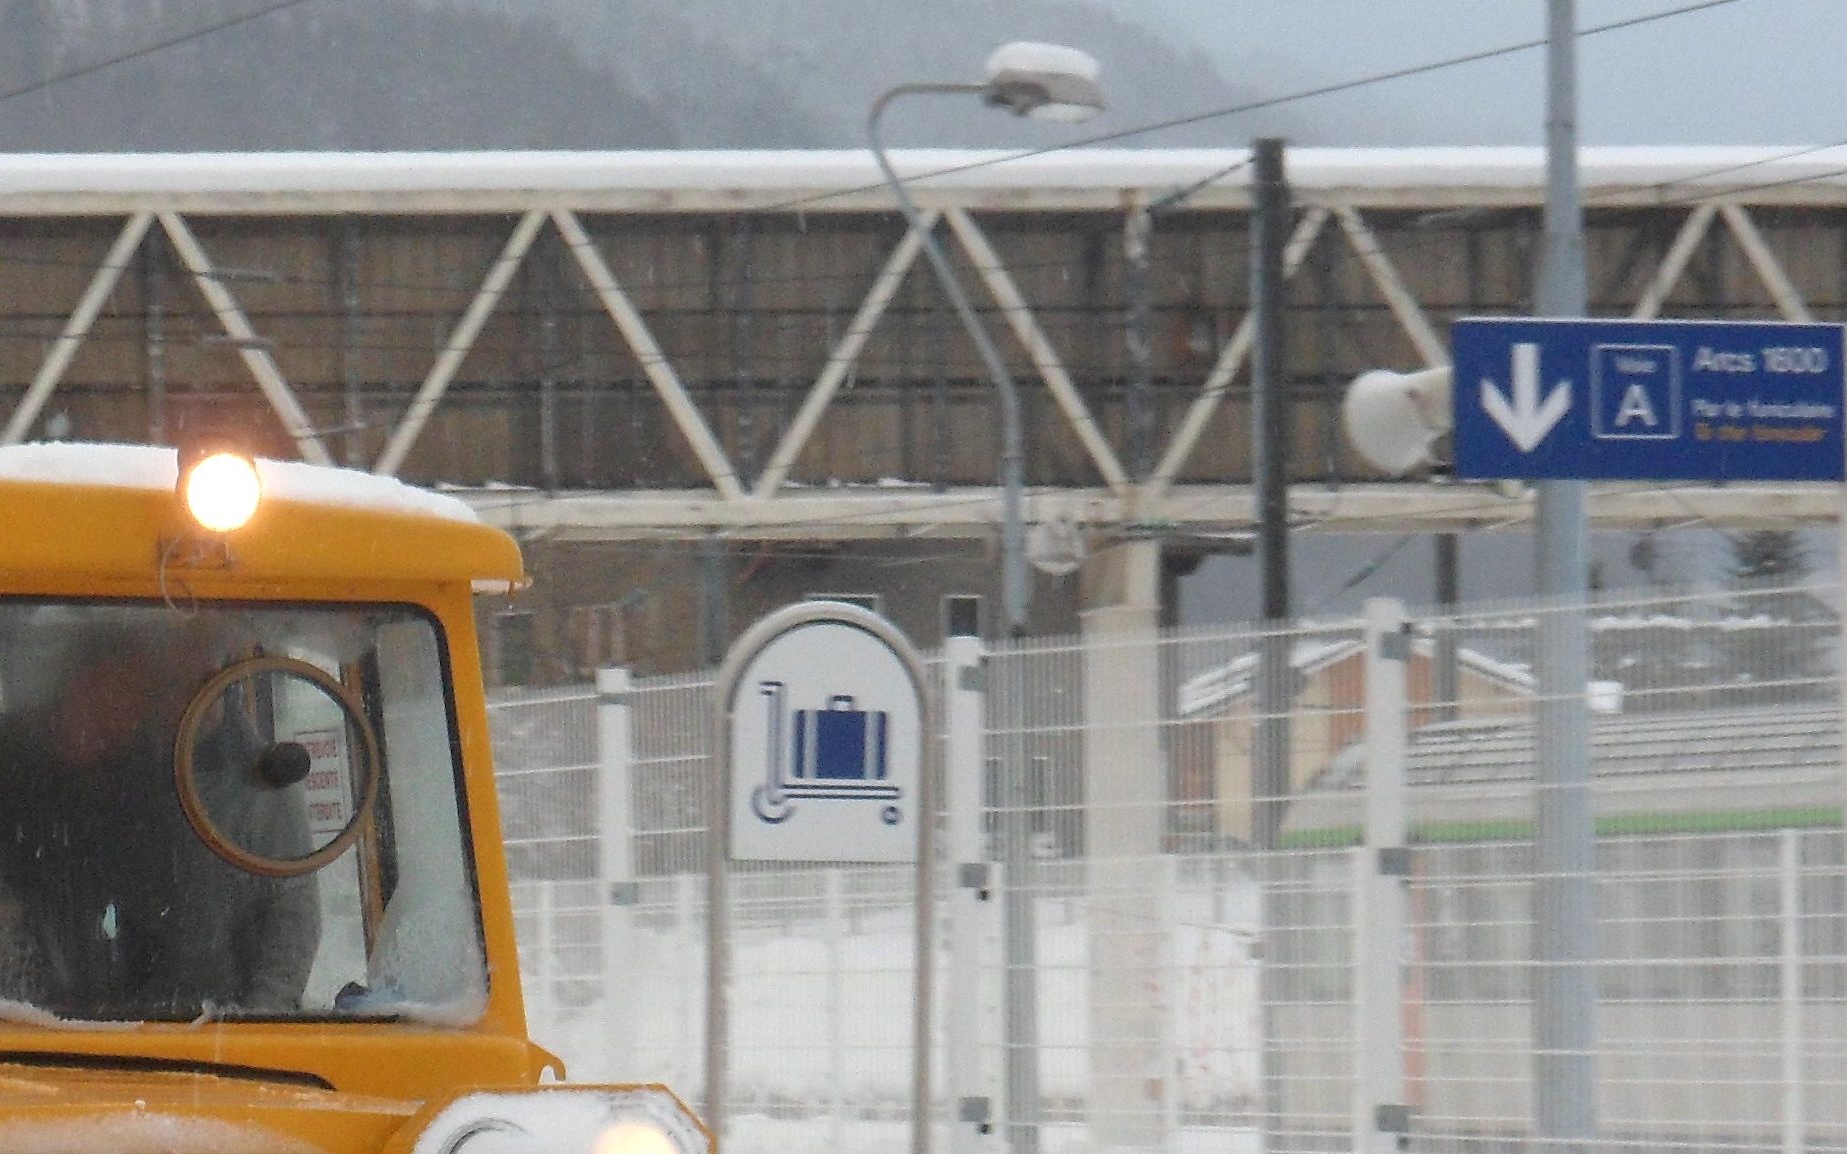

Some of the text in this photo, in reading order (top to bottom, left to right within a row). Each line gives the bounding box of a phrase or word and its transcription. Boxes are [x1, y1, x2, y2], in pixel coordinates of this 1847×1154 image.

[1693, 346, 1829, 373] Arcs 1600
[1615, 384, 1657, 427] A
